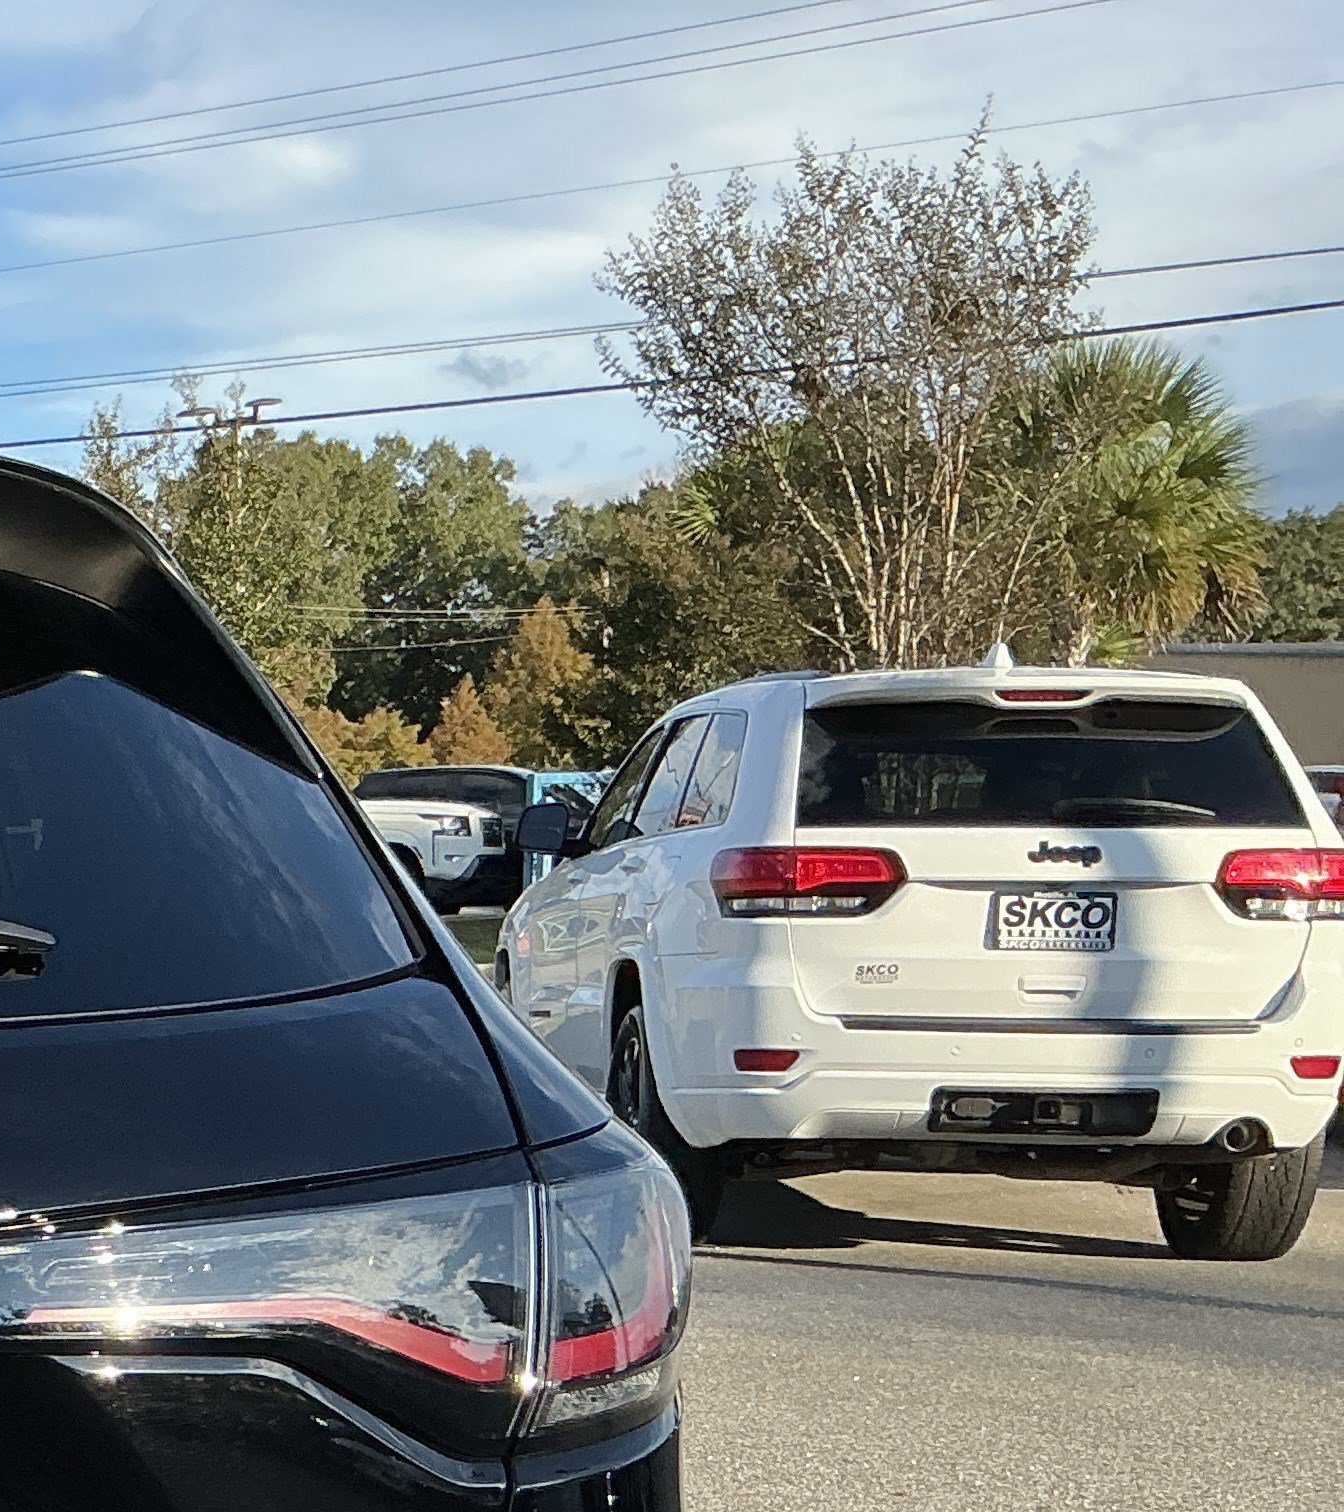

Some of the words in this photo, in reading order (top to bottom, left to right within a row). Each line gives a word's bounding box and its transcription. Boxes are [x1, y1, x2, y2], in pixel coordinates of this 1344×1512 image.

[1027, 840, 1102, 868] Jeep
[1002, 900, 1111, 929] SKCO
[854, 963, 899, 976] SKCO
